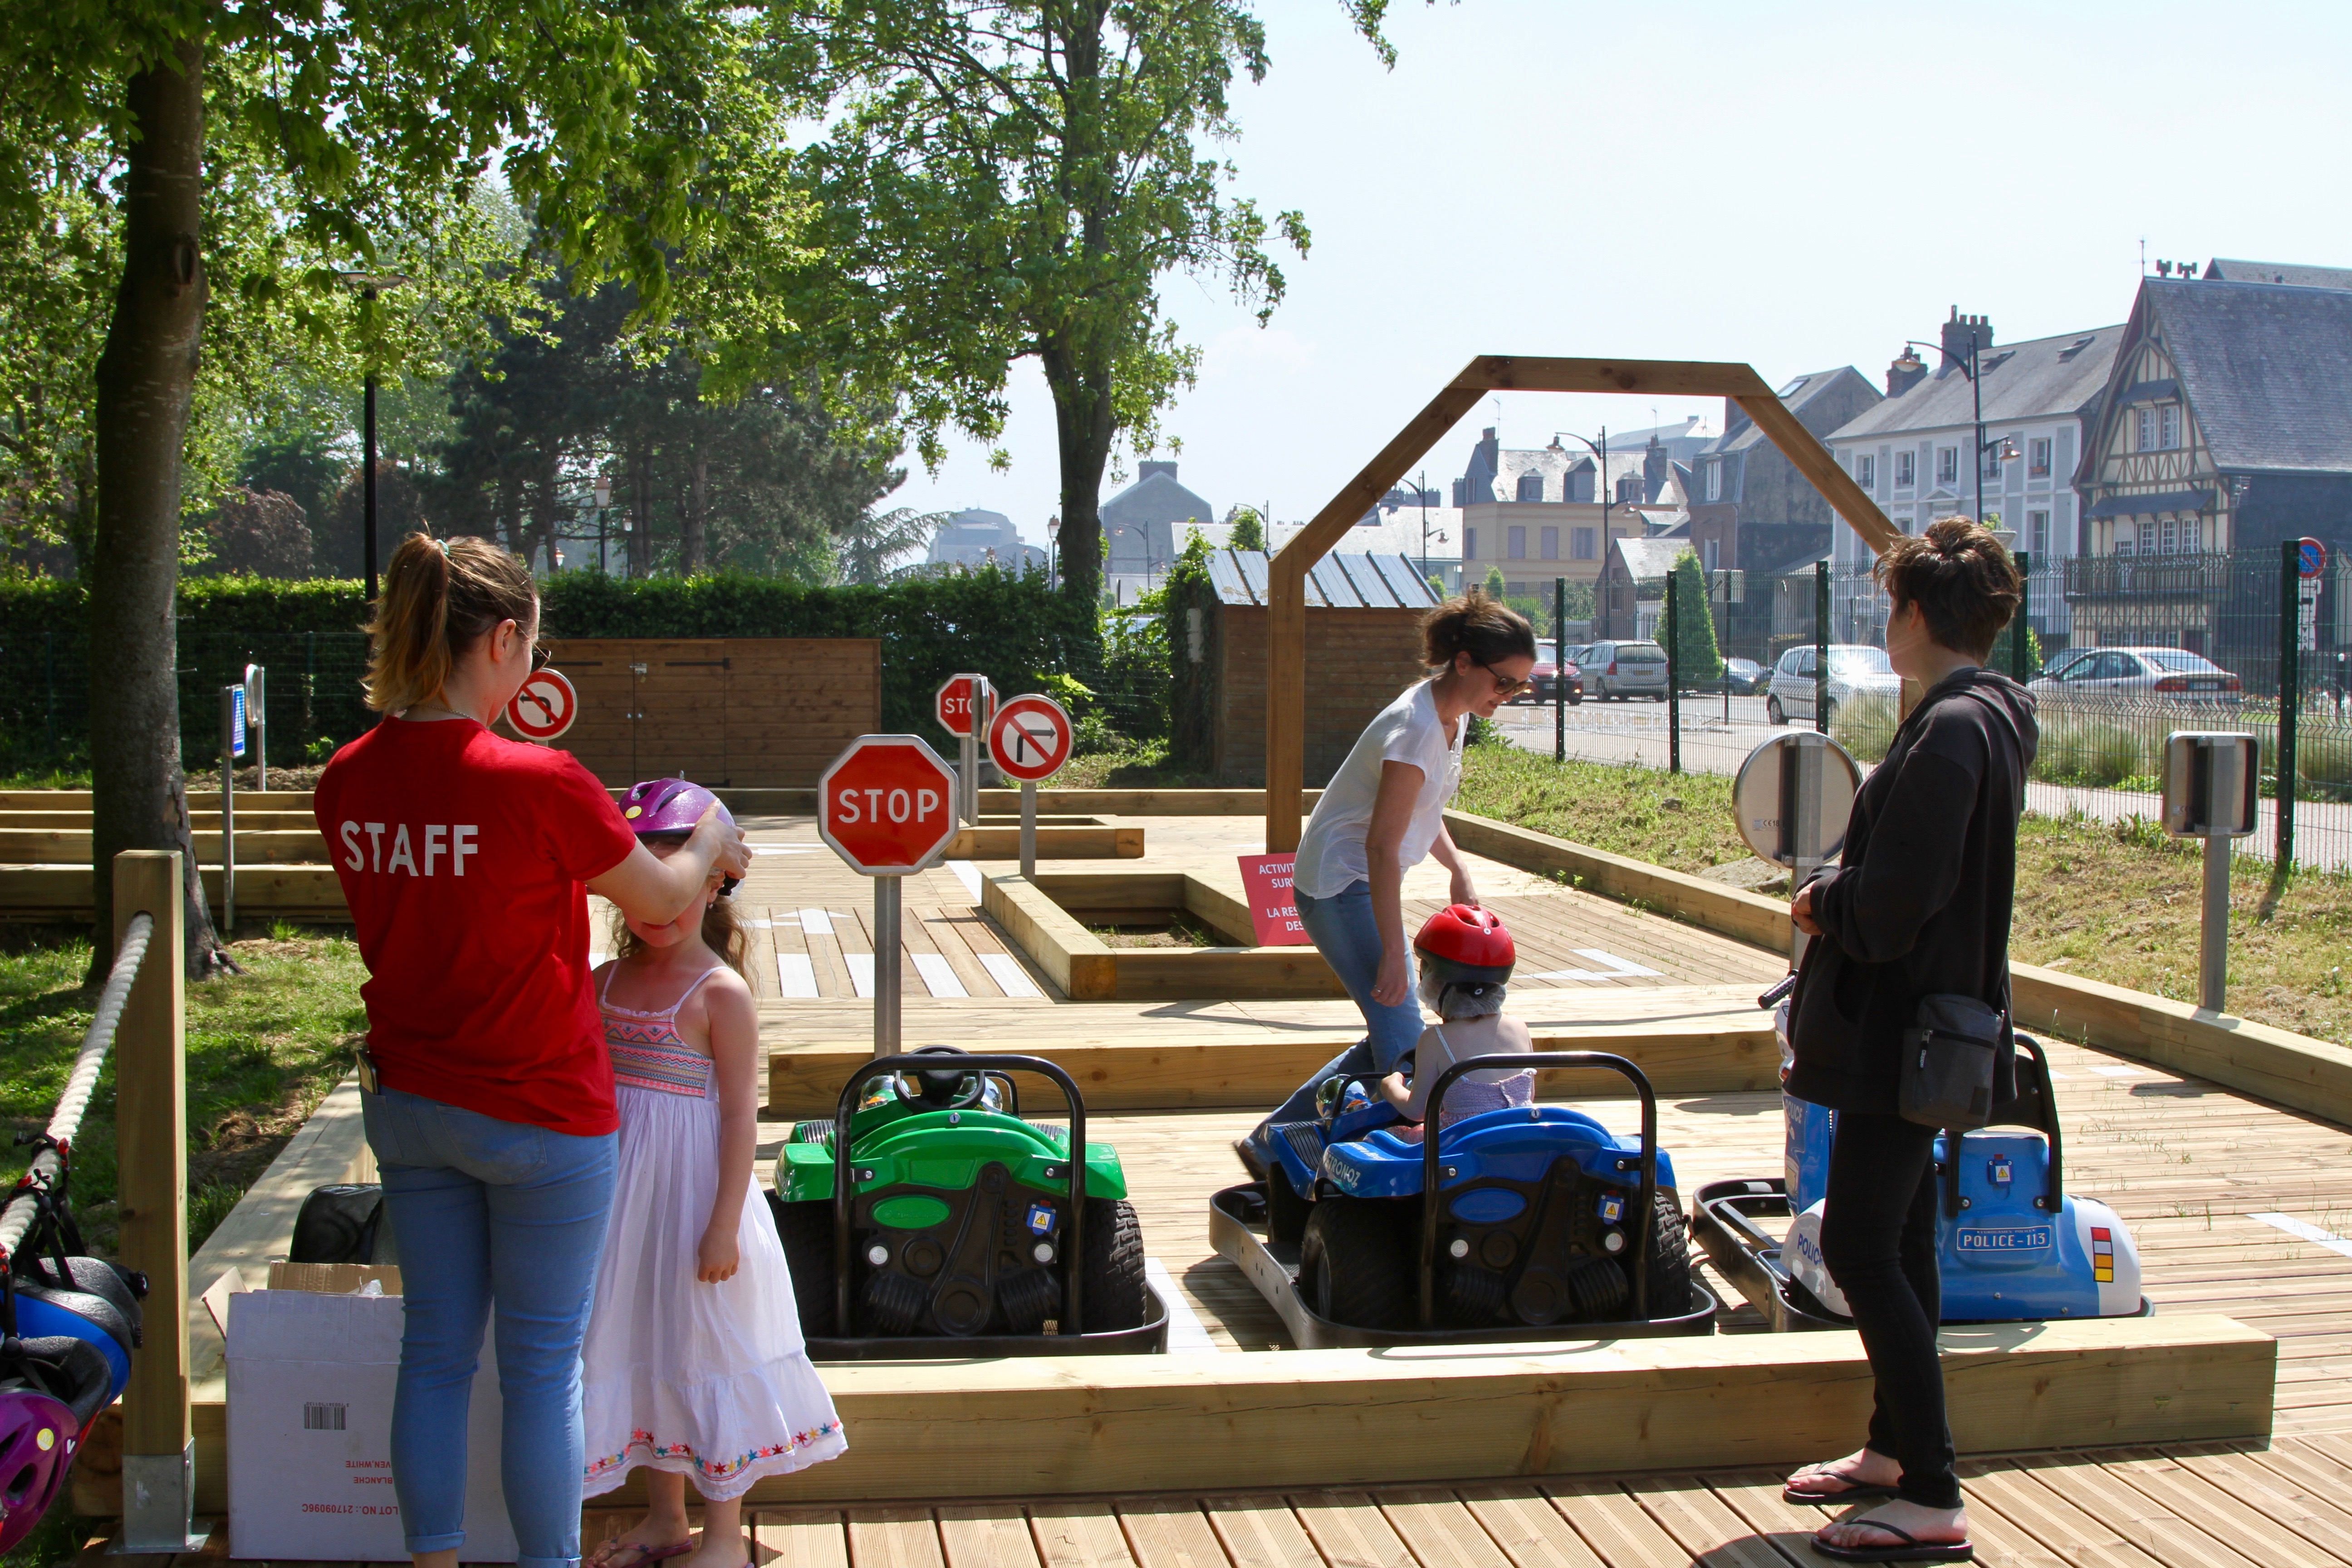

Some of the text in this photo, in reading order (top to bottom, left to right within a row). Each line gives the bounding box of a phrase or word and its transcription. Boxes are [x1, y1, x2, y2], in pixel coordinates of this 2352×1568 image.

[838, 788, 939, 823] STOP
[340, 820, 479, 877] STAFF
[1259, 863, 1294, 875] ACTIVIT
[1266, 906, 1299, 918] LA RES
[353, 1476, 393, 1485] BLANCHE
[302, 1503, 353, 1514] 21709096C
[378, 1506, 399, 1515] LOT
